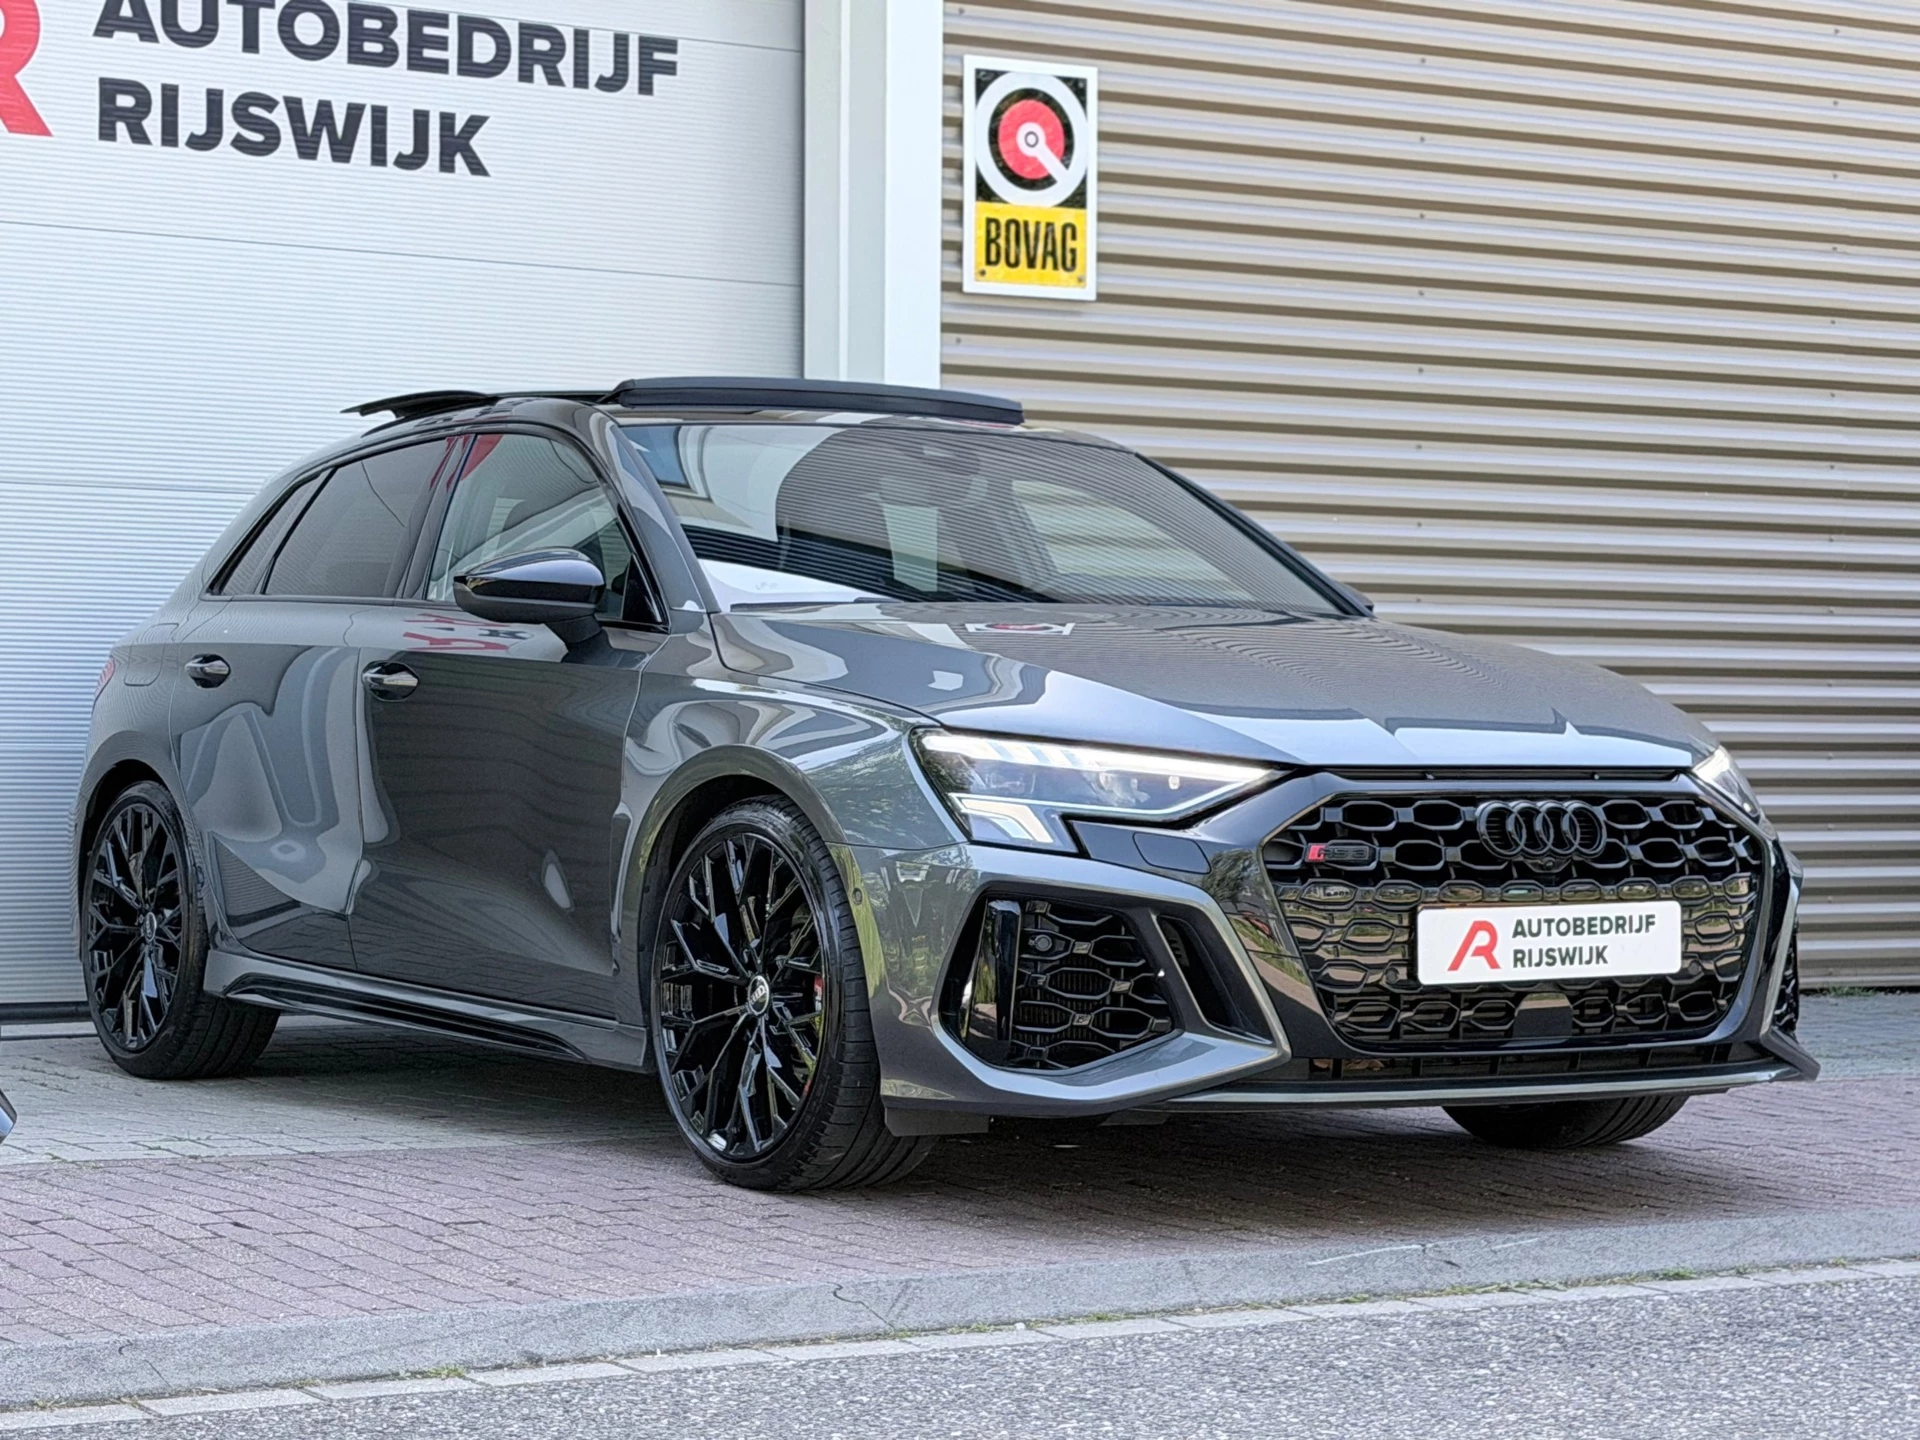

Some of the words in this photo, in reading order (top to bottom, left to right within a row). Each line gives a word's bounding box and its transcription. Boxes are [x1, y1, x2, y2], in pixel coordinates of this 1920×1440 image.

[92, 0, 679, 97] AUTOBEDRIJF
[98, 77, 491, 178] RIJSWIJK
[985, 216, 1077, 272] BOVAG
[1512, 914, 1656, 938] AUTOBEDRIJF
[1513, 945, 1609, 969] RIJSWIJK
